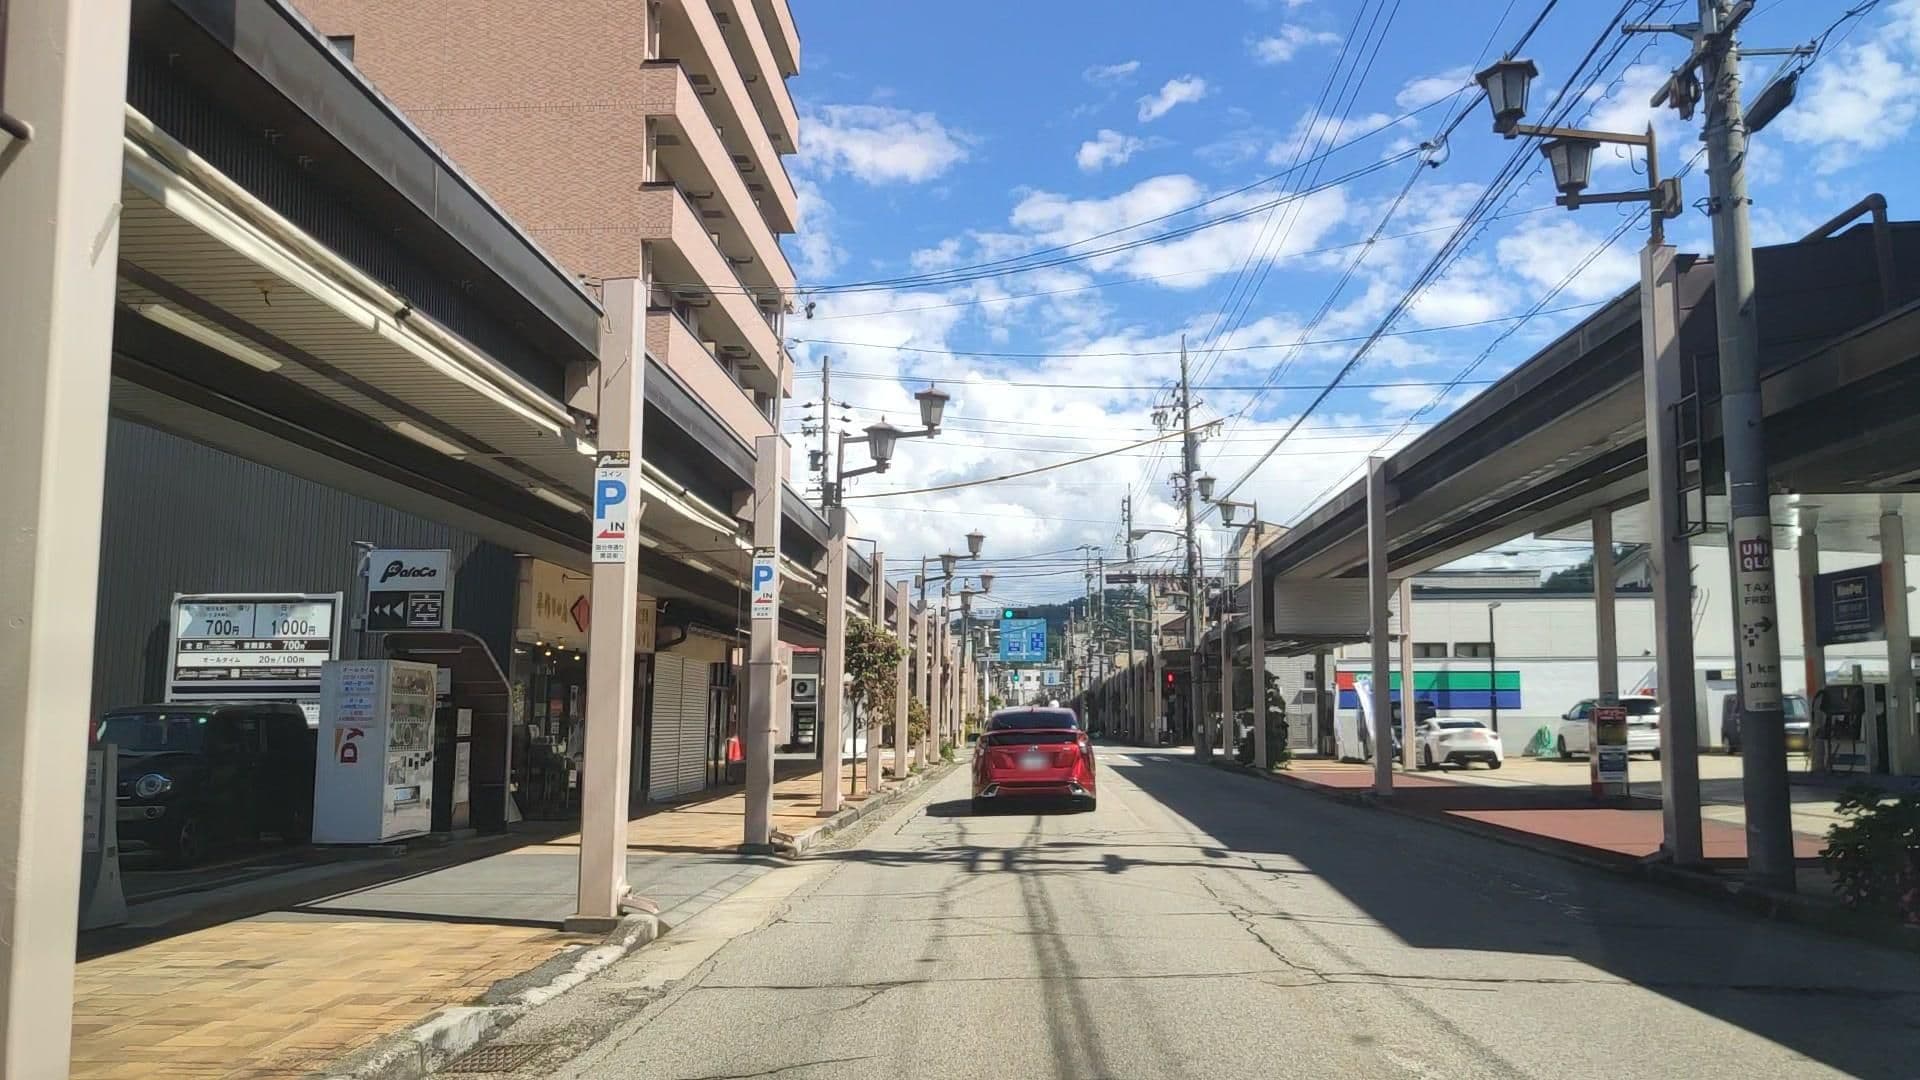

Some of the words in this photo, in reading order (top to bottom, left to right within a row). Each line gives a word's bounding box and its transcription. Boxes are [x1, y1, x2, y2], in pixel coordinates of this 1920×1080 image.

[596, 480, 626, 519] P
[610, 522, 625, 531] IN
[1743, 543, 1768, 555] UNI
[754, 565, 773, 591] P
[1744, 583, 1769, 592] TAX
[205, 619, 239, 635] 700円
